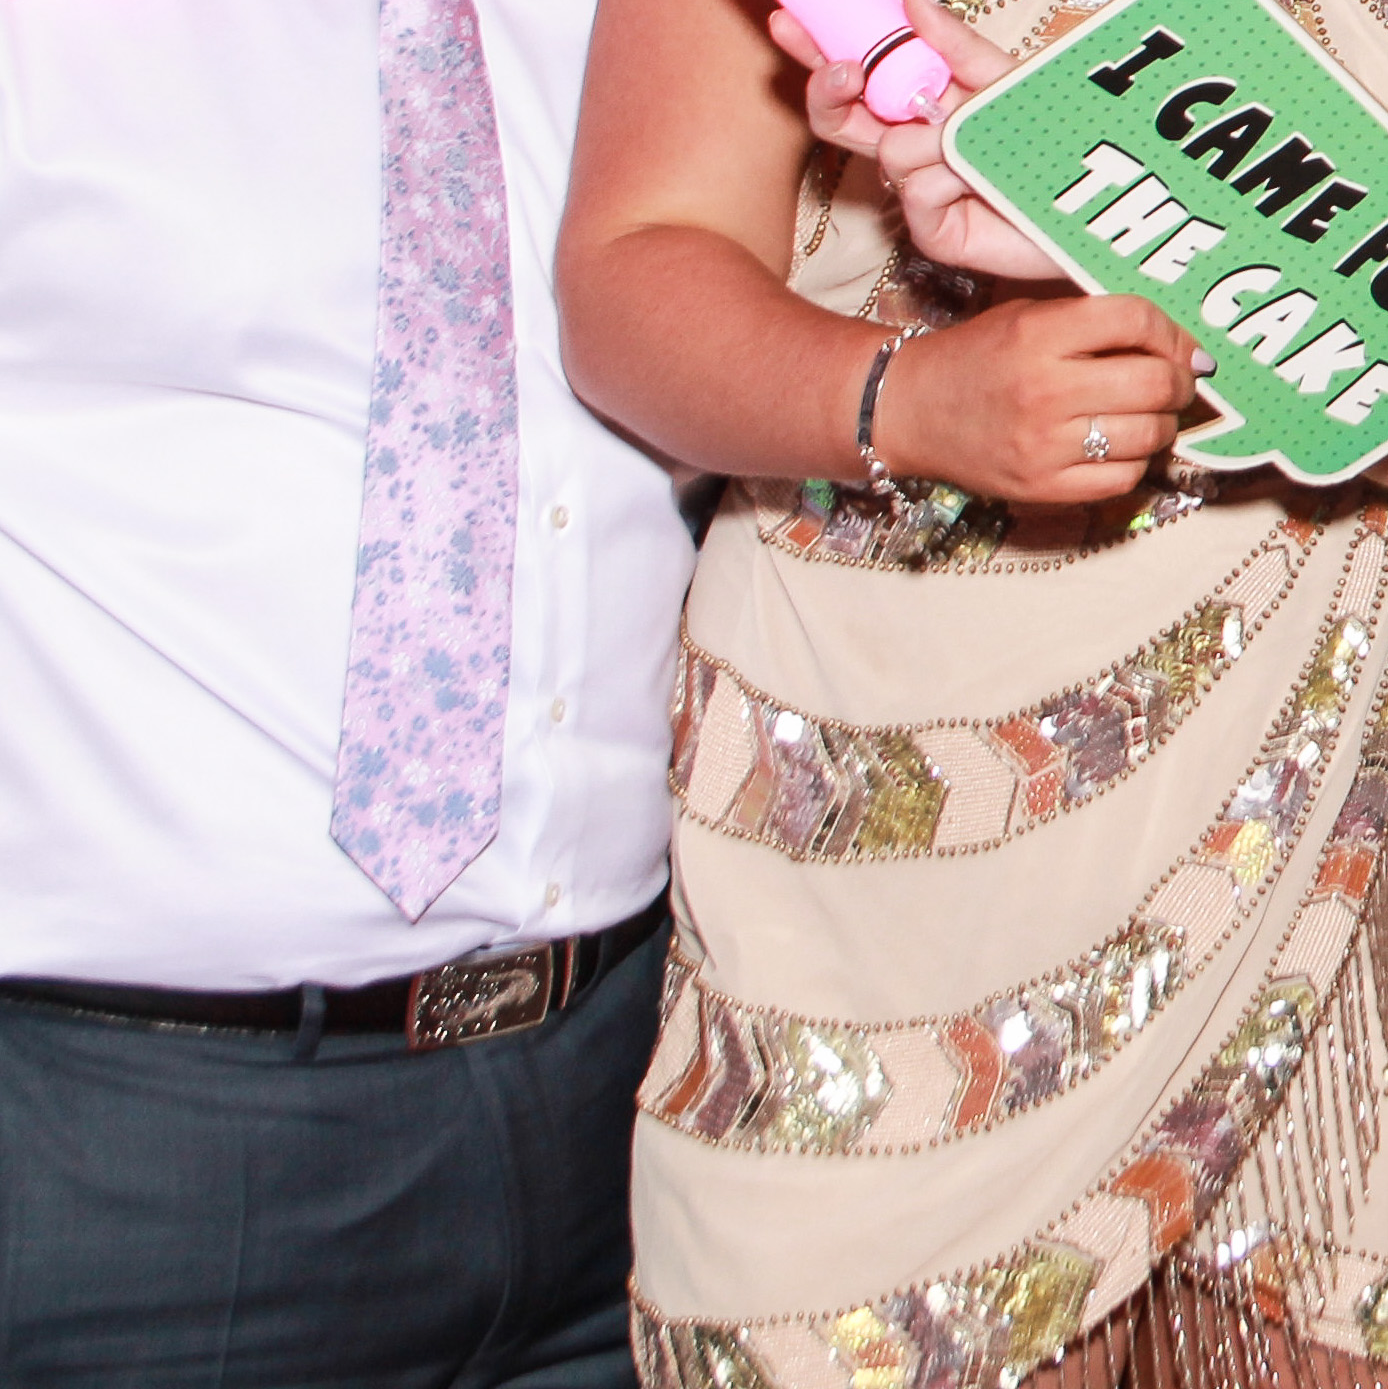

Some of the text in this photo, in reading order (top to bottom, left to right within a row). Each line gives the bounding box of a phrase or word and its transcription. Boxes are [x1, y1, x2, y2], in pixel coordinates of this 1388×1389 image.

[1053, 139, 1226, 284] THE
[1087, 25, 1185, 96] I
[1155, 76, 1369, 244] CAME
